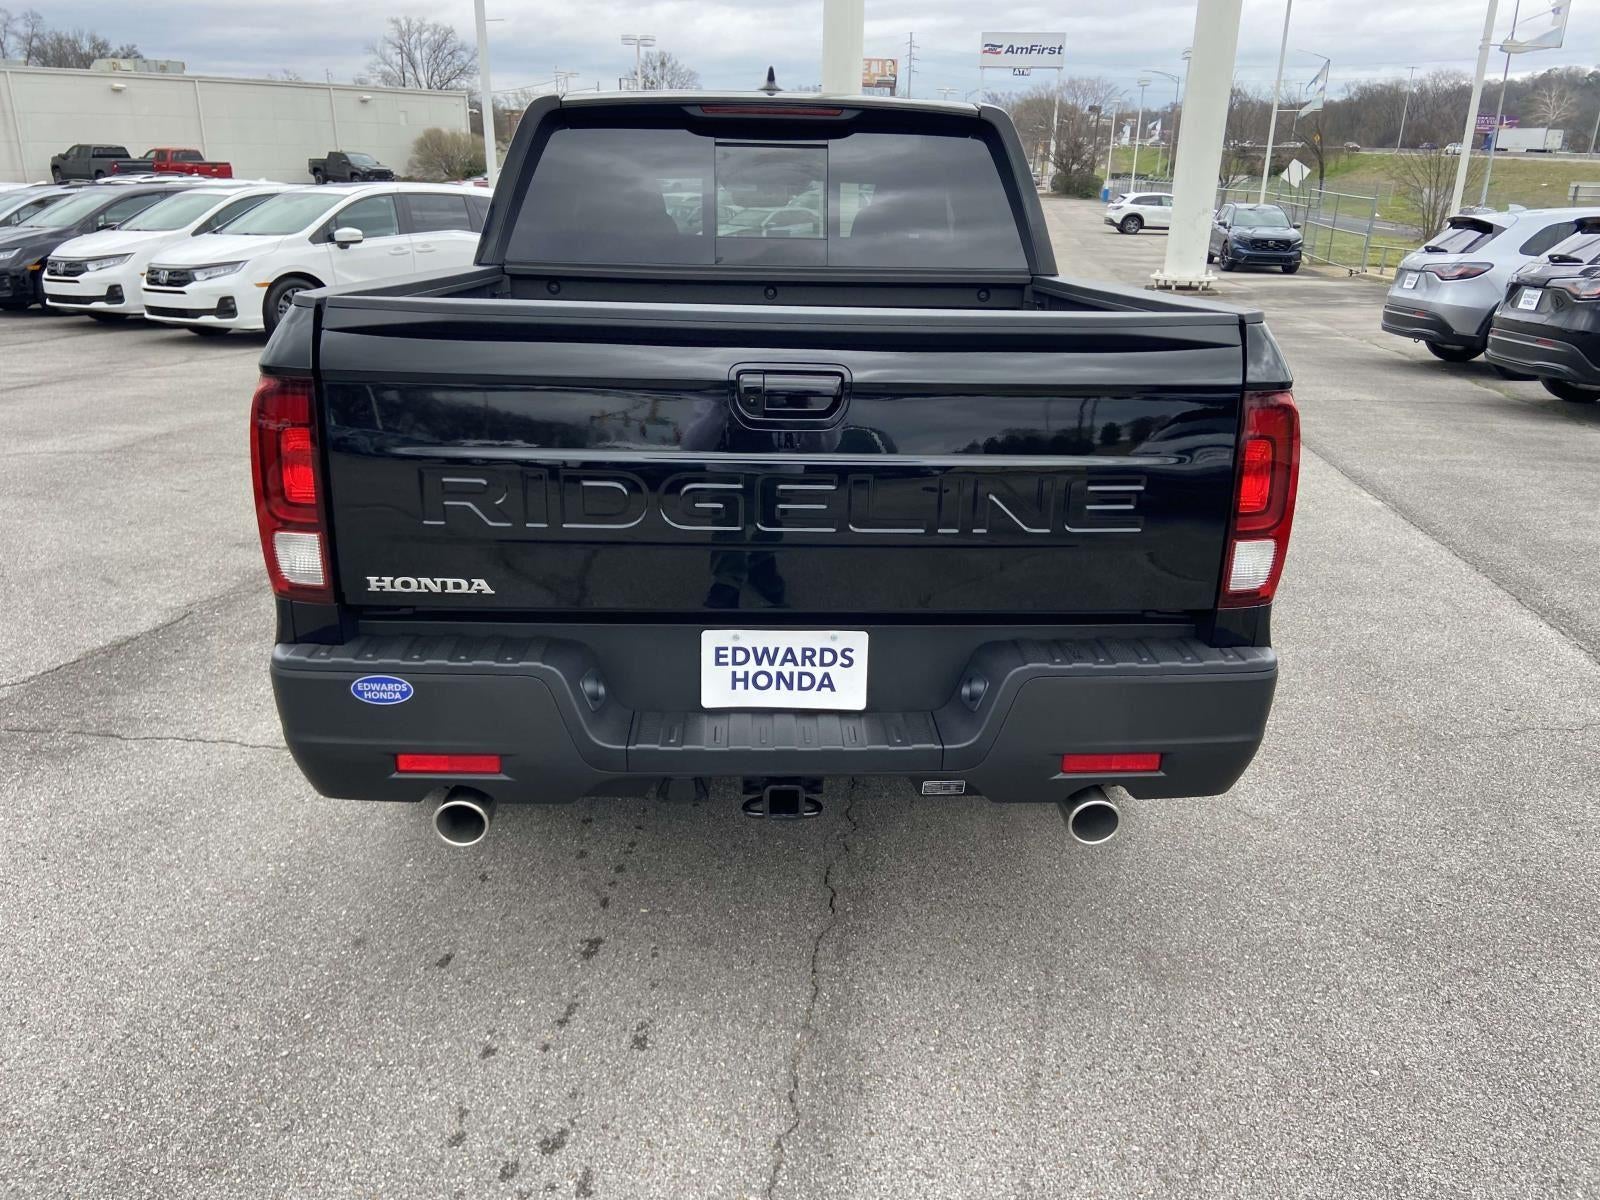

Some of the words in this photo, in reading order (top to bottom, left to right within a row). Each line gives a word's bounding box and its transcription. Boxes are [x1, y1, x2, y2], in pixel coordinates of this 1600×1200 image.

[1004, 44, 1064, 55] AmFirst
[418, 468, 1147, 533] RIDGELINE
[366, 576, 496, 594] HONDA
[714, 646, 855, 669] EDWARDS
[357, 682, 408, 692] EDWARDS
[731, 670, 837, 693] HONDA
[363, 691, 402, 700] HONDA
